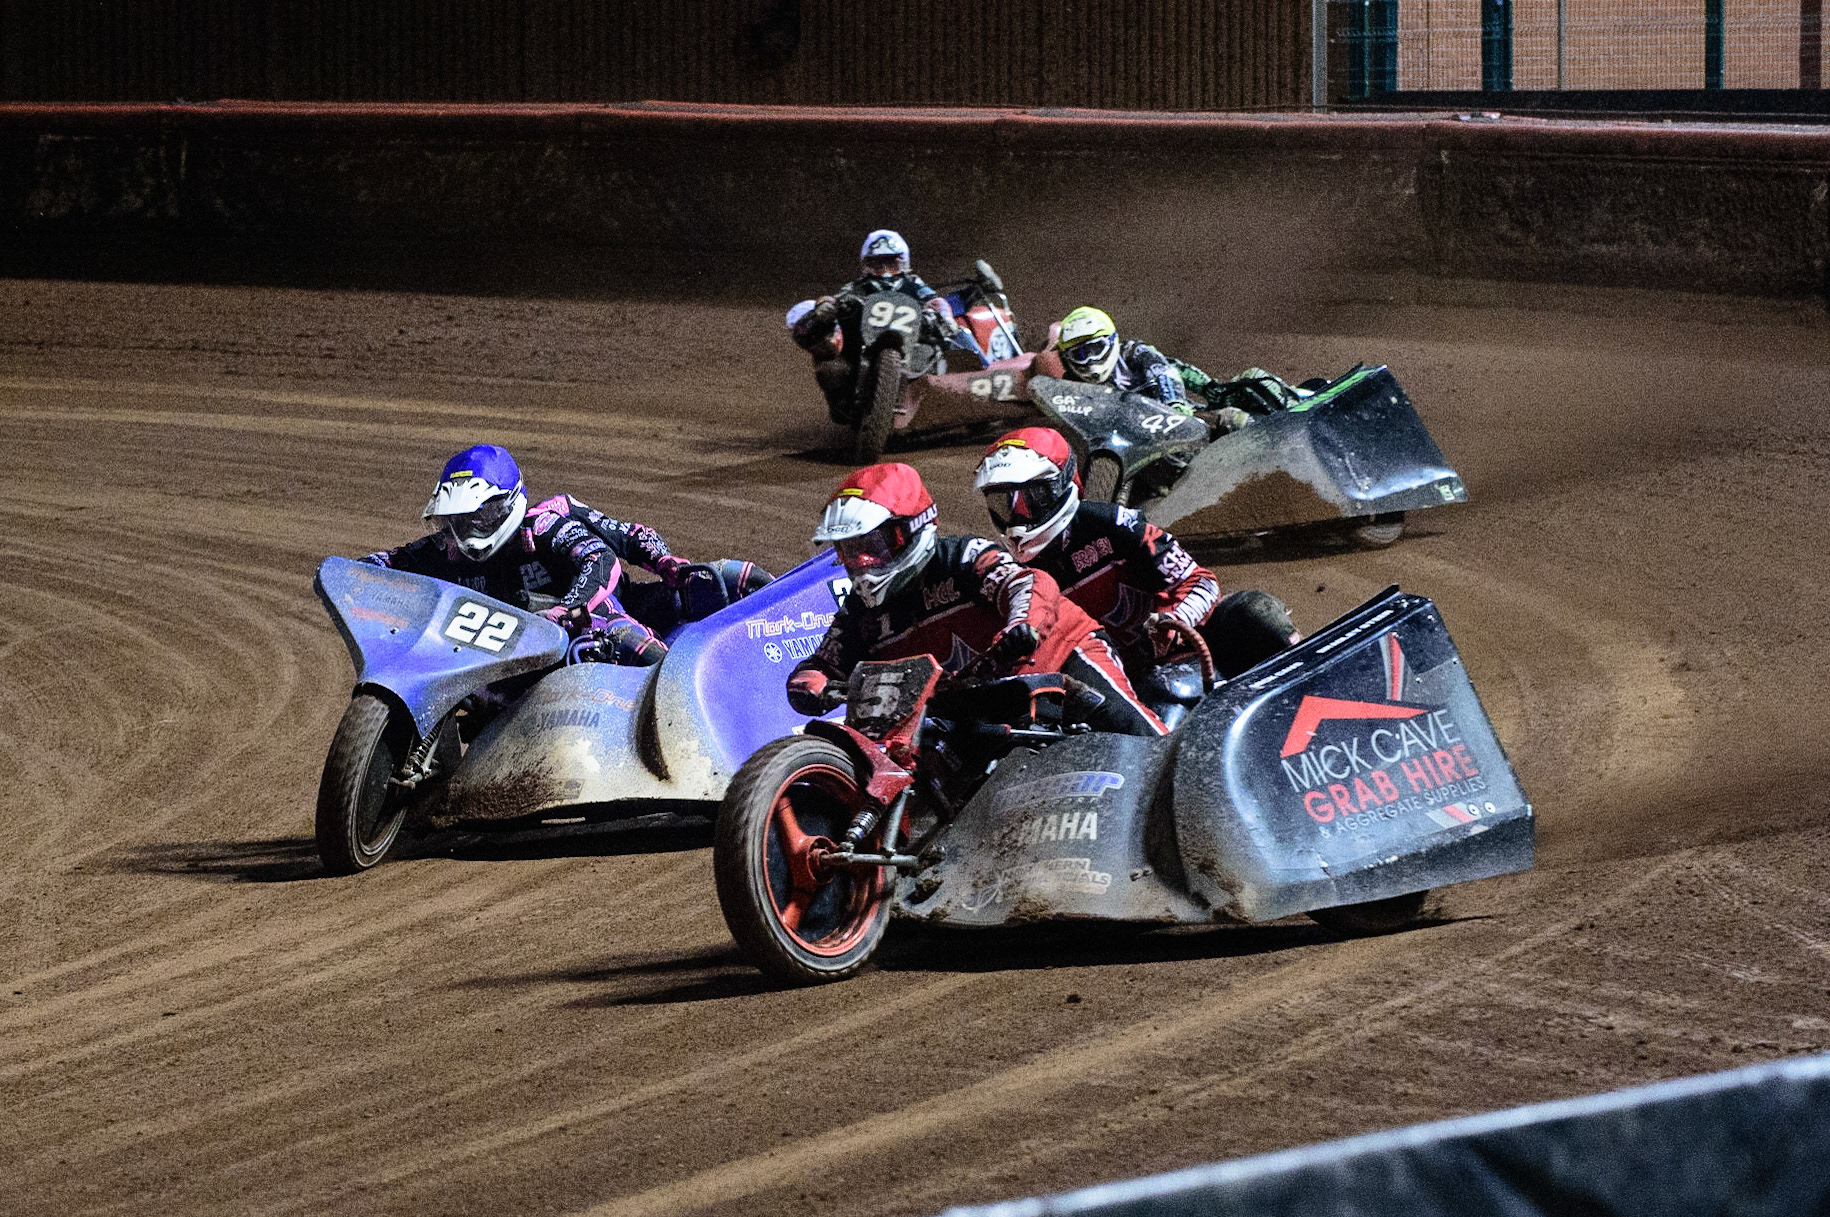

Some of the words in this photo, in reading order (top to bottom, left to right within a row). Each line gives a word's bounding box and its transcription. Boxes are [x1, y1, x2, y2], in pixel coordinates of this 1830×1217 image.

[867, 301, 917, 333] 92
[970, 374, 1017, 402] 92
[1141, 414, 1187, 434] 49
[519, 561, 552, 591] 22
[444, 601, 519, 652] 22
[781, 631, 826, 660] YAMA
[1281, 736, 1373, 793] MICK
[1371, 709, 1461, 763] CAVE
[1303, 770, 1399, 824] GRAB
[1400, 744, 1480, 793] HIRE
[1318, 825, 1331, 840] &
[1335, 795, 1423, 834] AGGREGATE
[1424, 775, 1487, 807] SUPPLIES
[1008, 810, 1098, 848] MAHA
